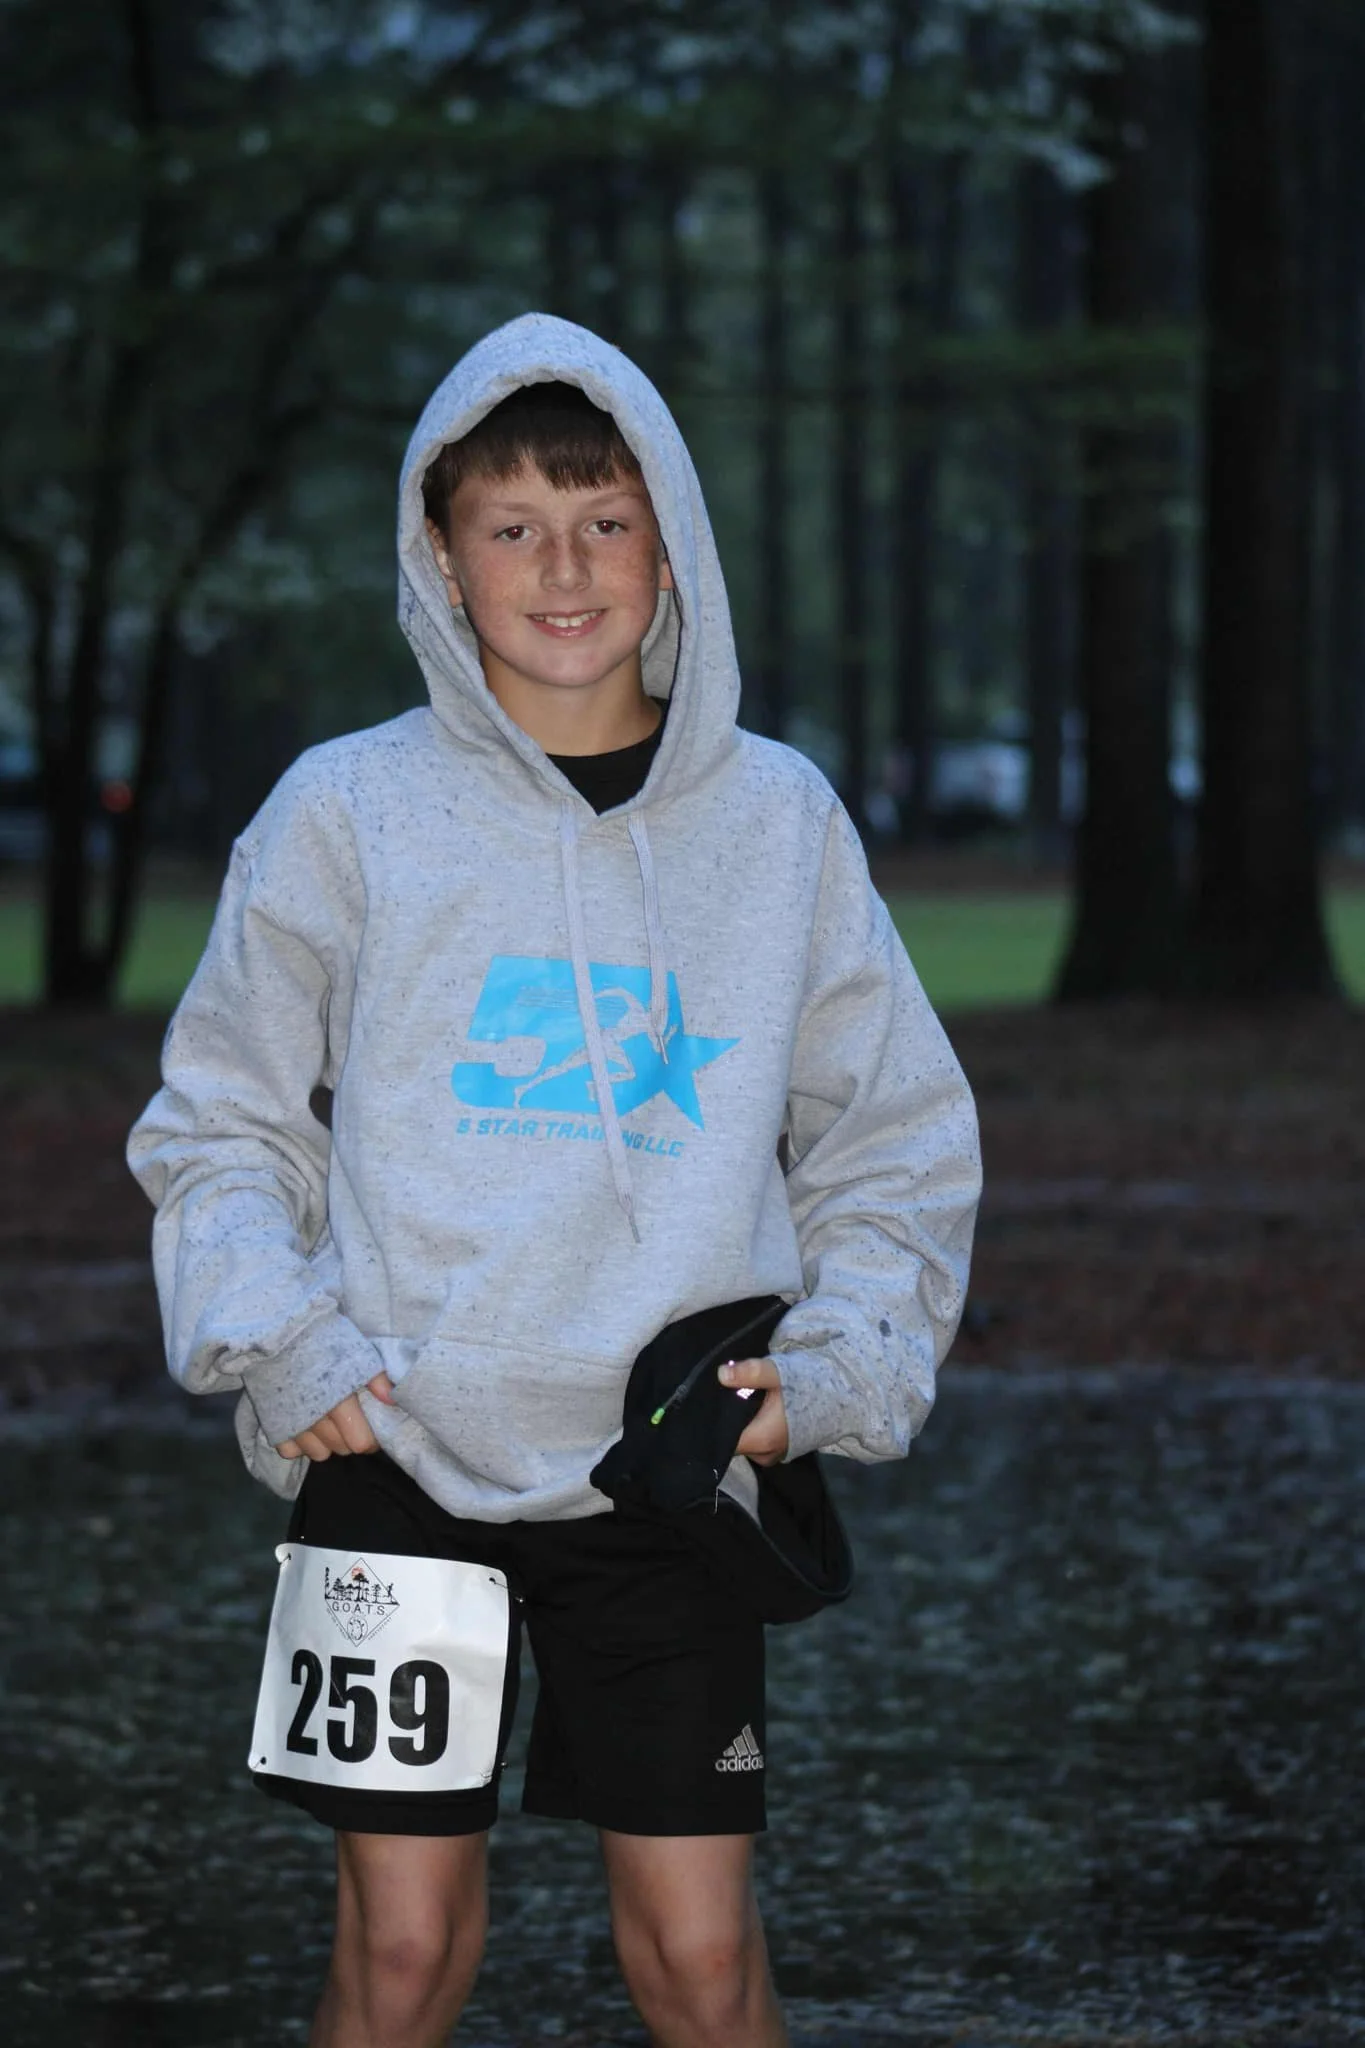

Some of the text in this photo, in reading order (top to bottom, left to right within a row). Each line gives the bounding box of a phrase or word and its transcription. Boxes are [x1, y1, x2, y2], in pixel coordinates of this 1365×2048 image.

[456, 1118, 472, 1136] 5
[476, 1118, 538, 1137] STAR
[645, 1136, 685, 1158] LLC
[286, 1648, 450, 1766] 259
